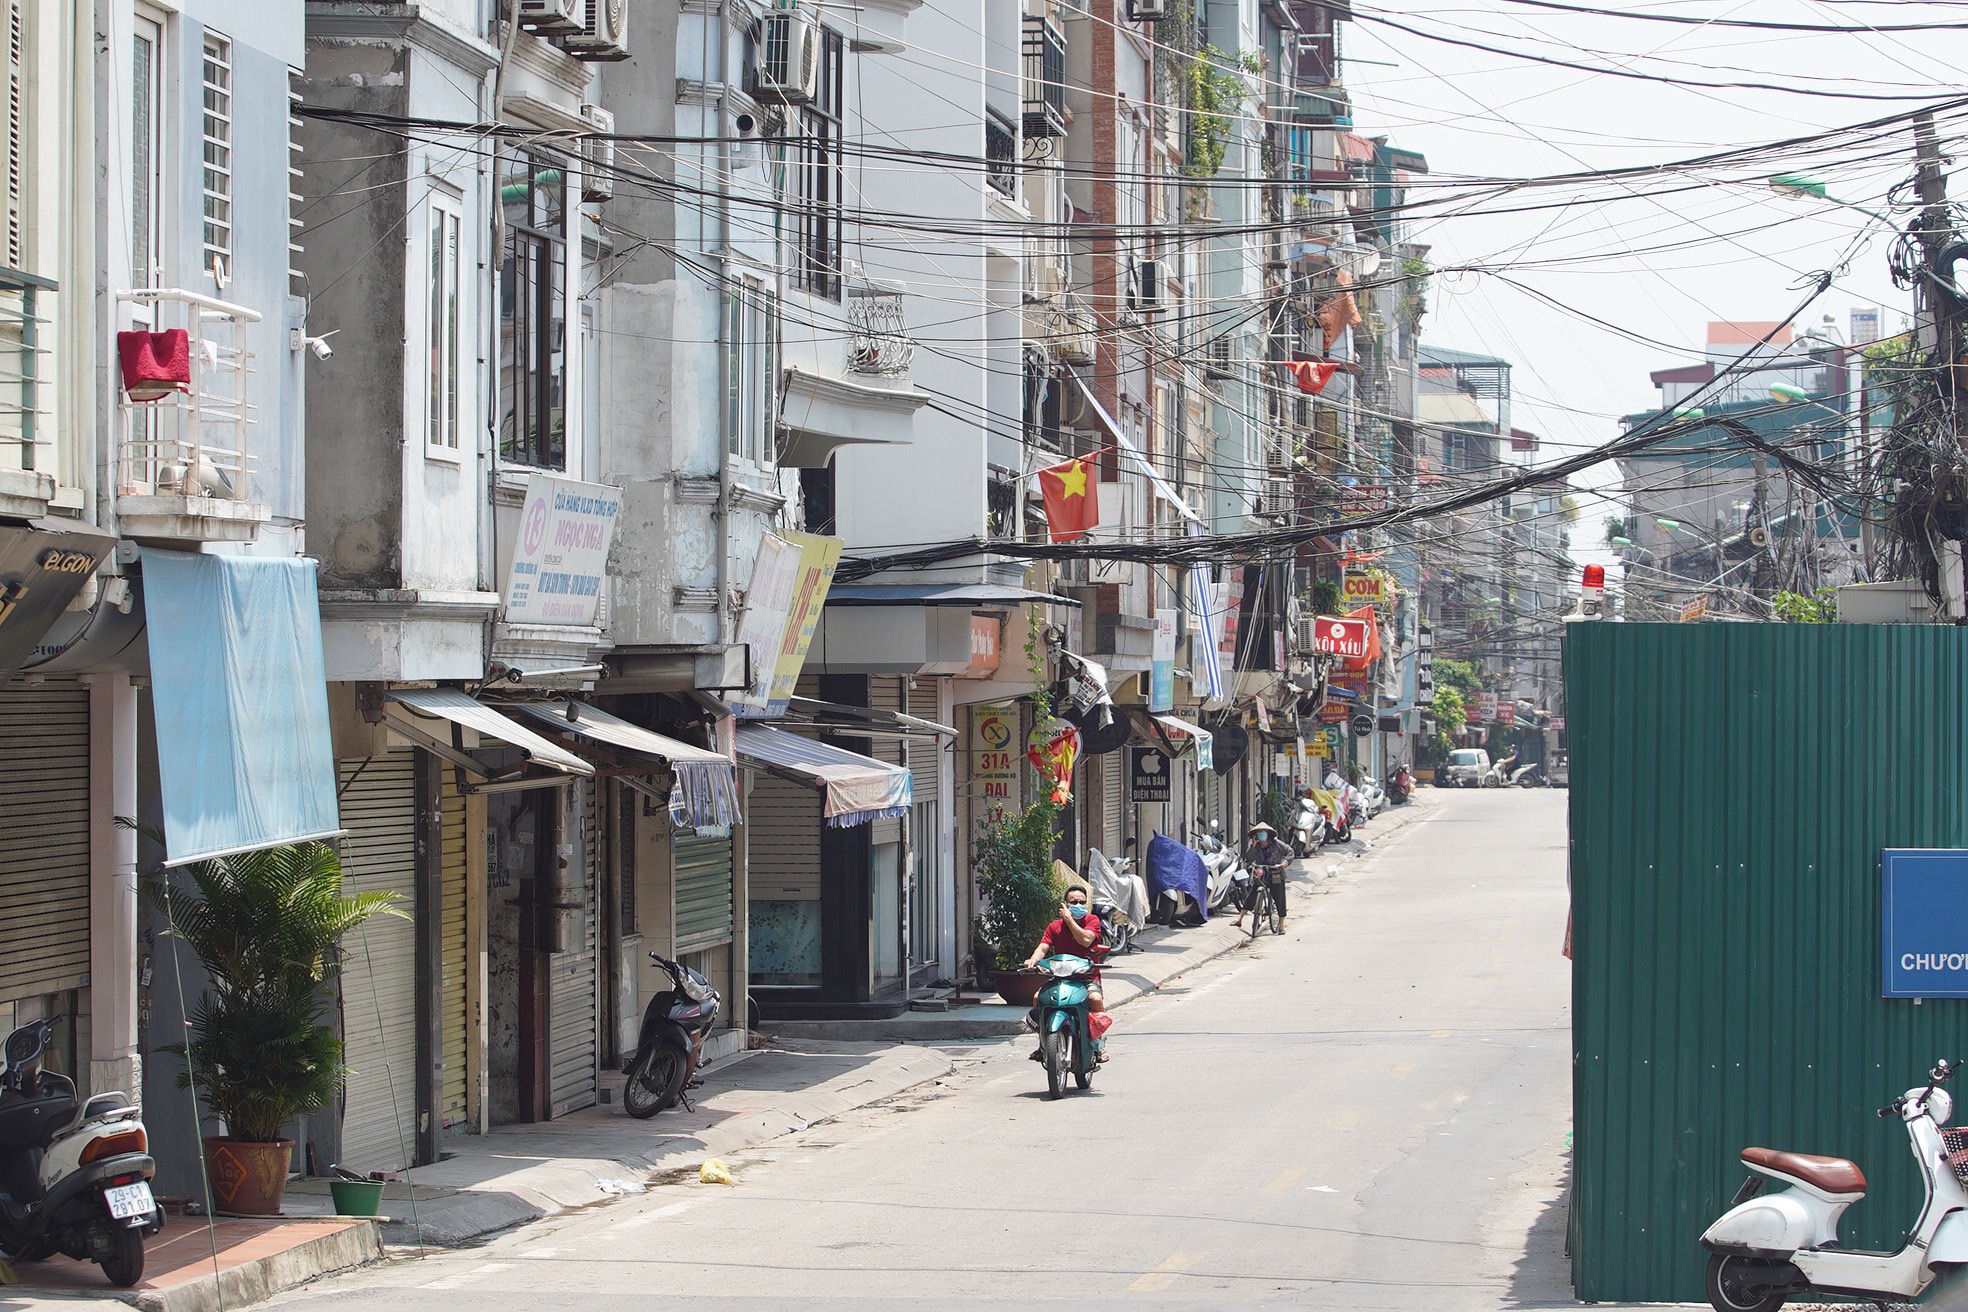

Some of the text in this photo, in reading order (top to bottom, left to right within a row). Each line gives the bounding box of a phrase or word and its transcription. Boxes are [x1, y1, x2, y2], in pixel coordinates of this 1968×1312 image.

[554, 519, 604, 552] NGỌC NGA
[1314, 635, 1361, 655] XÔI XÍU
[981, 752, 1010, 770] 31A
[1136, 774, 1166, 786] MUA BÁN
[1133, 788, 1169, 801] ĐIỆN THOẠI
[111, 1185, 143, 1203] 29-C1
[113, 1198, 150, 1217] 281.07
